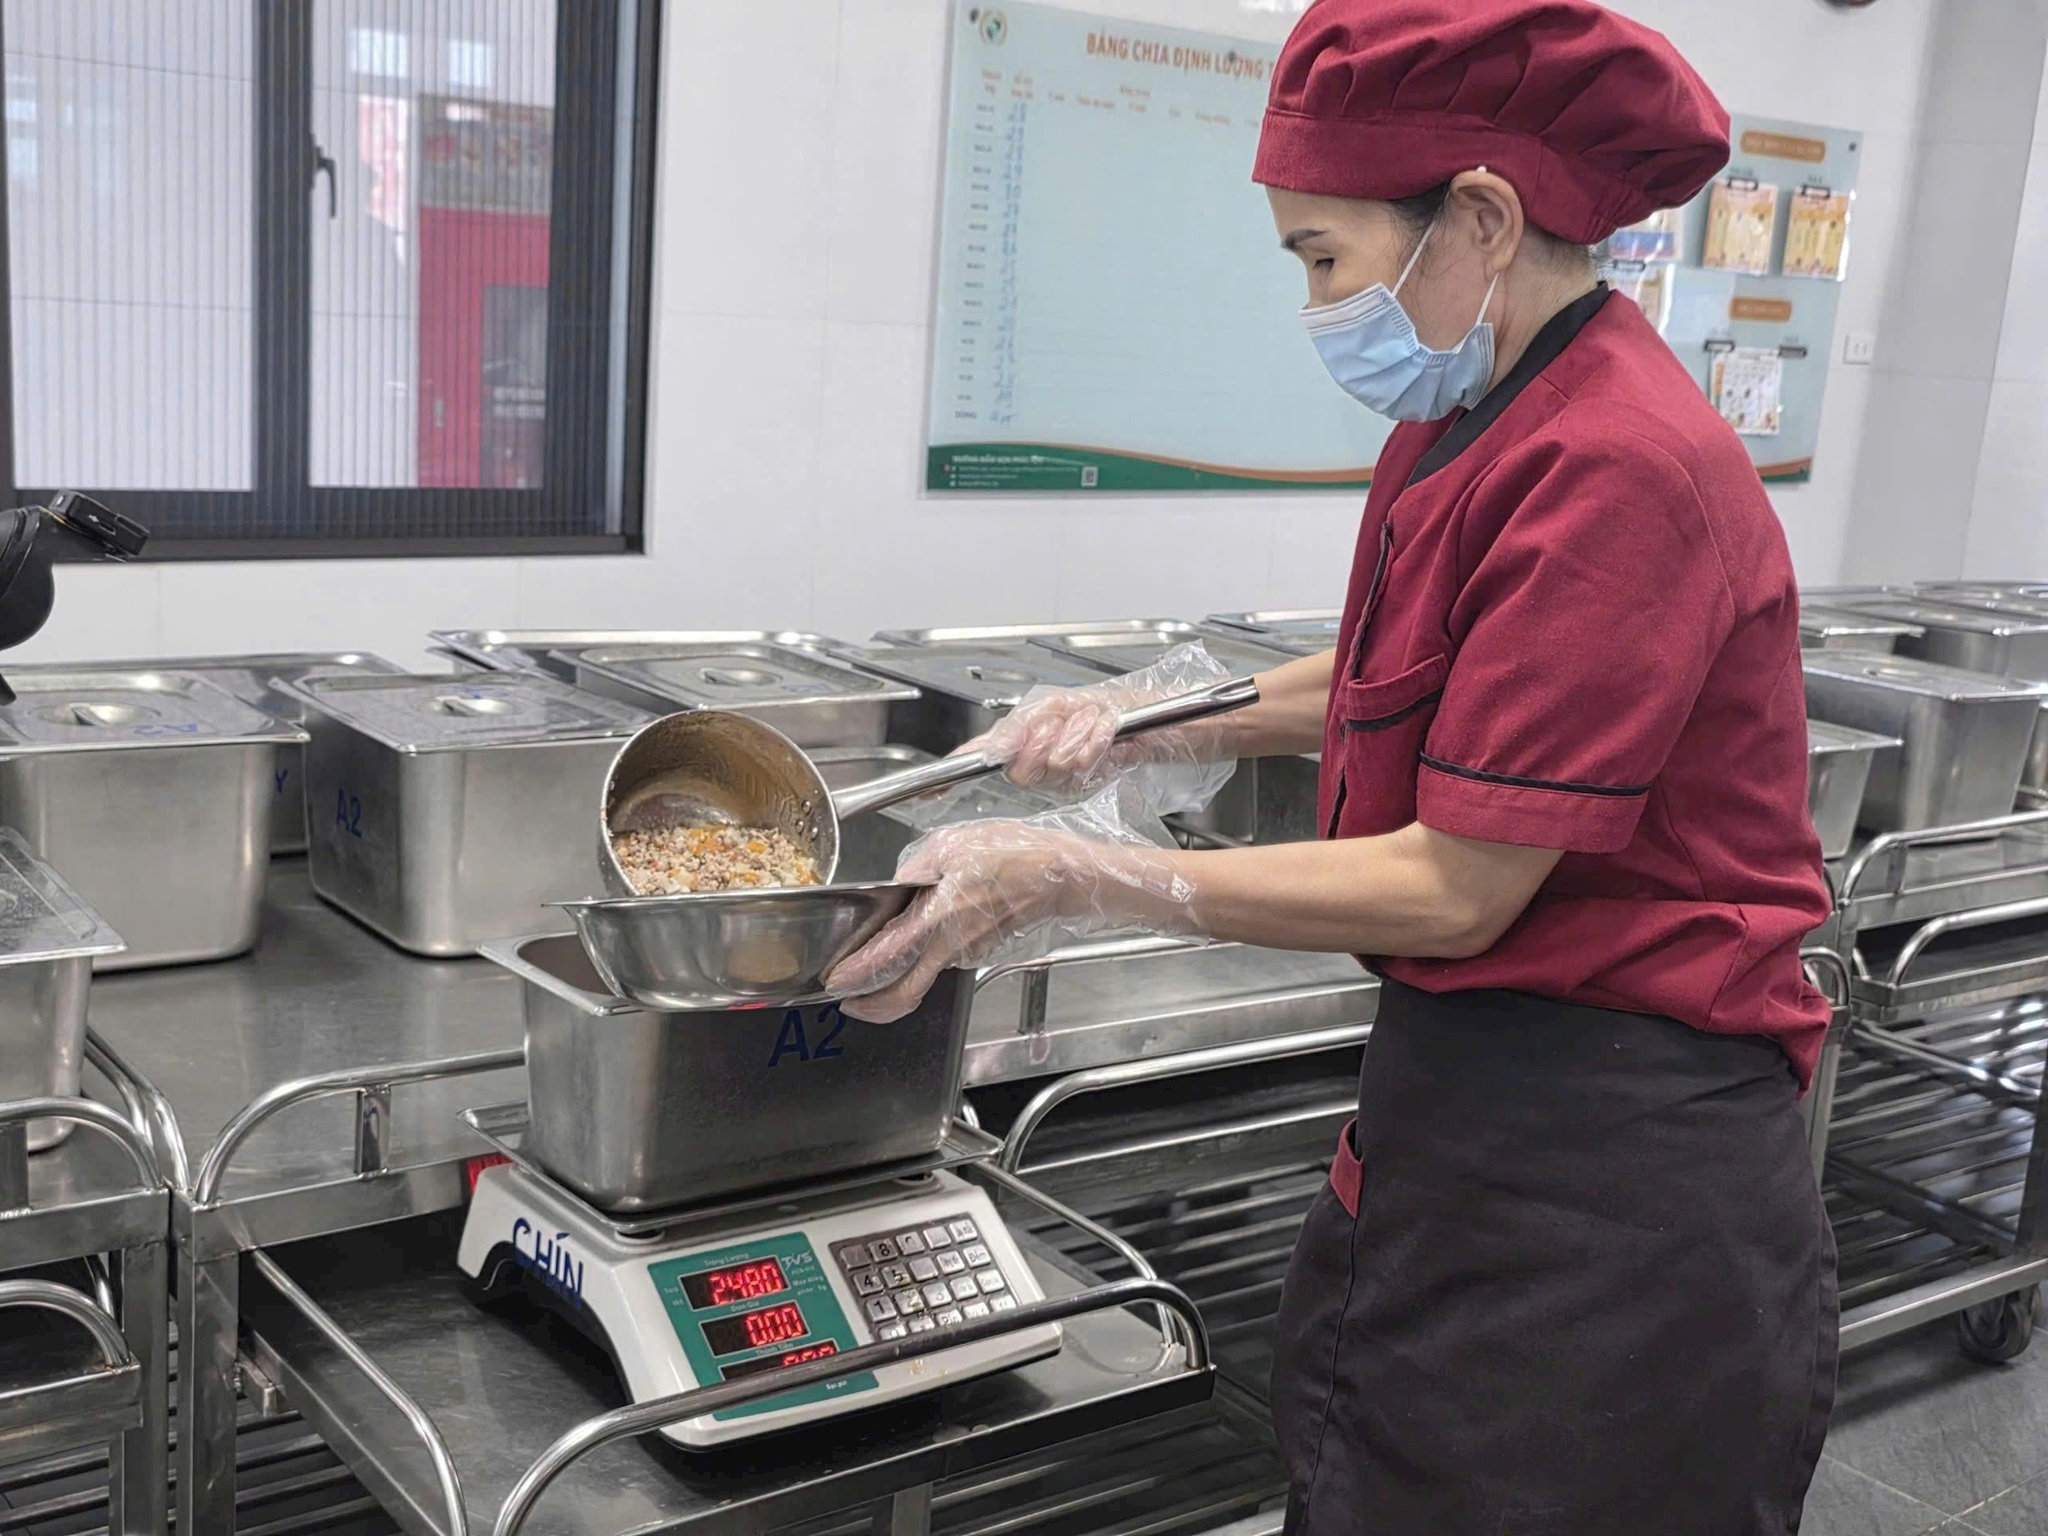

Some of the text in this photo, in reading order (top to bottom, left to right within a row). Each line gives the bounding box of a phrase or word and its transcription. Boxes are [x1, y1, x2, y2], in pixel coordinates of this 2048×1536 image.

[1087, 30, 1129, 60] BẢNG
[1132, 40, 1169, 65] CHIA
[1173, 47, 1212, 74] ĐỊNH
[336, 789, 362, 838] A2
[768, 1003, 846, 1067] A2
[513, 1217, 583, 1308] CHÍN
[878, 1243, 890, 1257] 8
[864, 1275, 873, 1287] 4
[874, 1301, 884, 1314] 1
